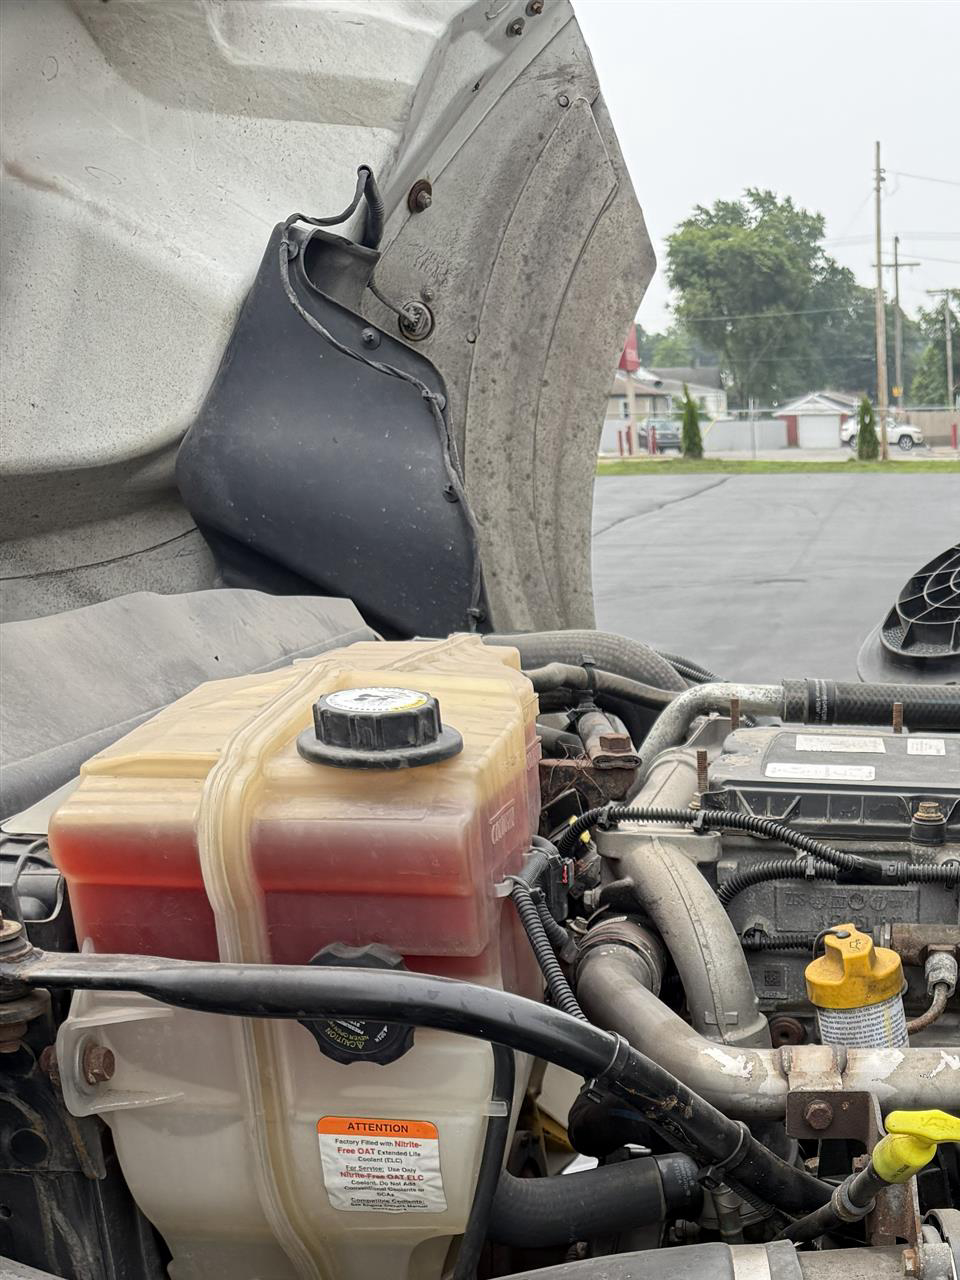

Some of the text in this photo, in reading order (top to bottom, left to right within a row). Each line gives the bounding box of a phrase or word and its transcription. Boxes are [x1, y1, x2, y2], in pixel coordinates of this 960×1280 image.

[325, 1027, 356, 1049] CAUTION
[347, 1122, 409, 1133] ATTENTION
[334, 1138, 360, 1147] Factory
[394, 1140, 422, 1148] Nitrite-
[337, 1146, 356, 1155] Free
[357, 1147, 375, 1155] OAT
[377, 1149, 408, 1157] Extended
